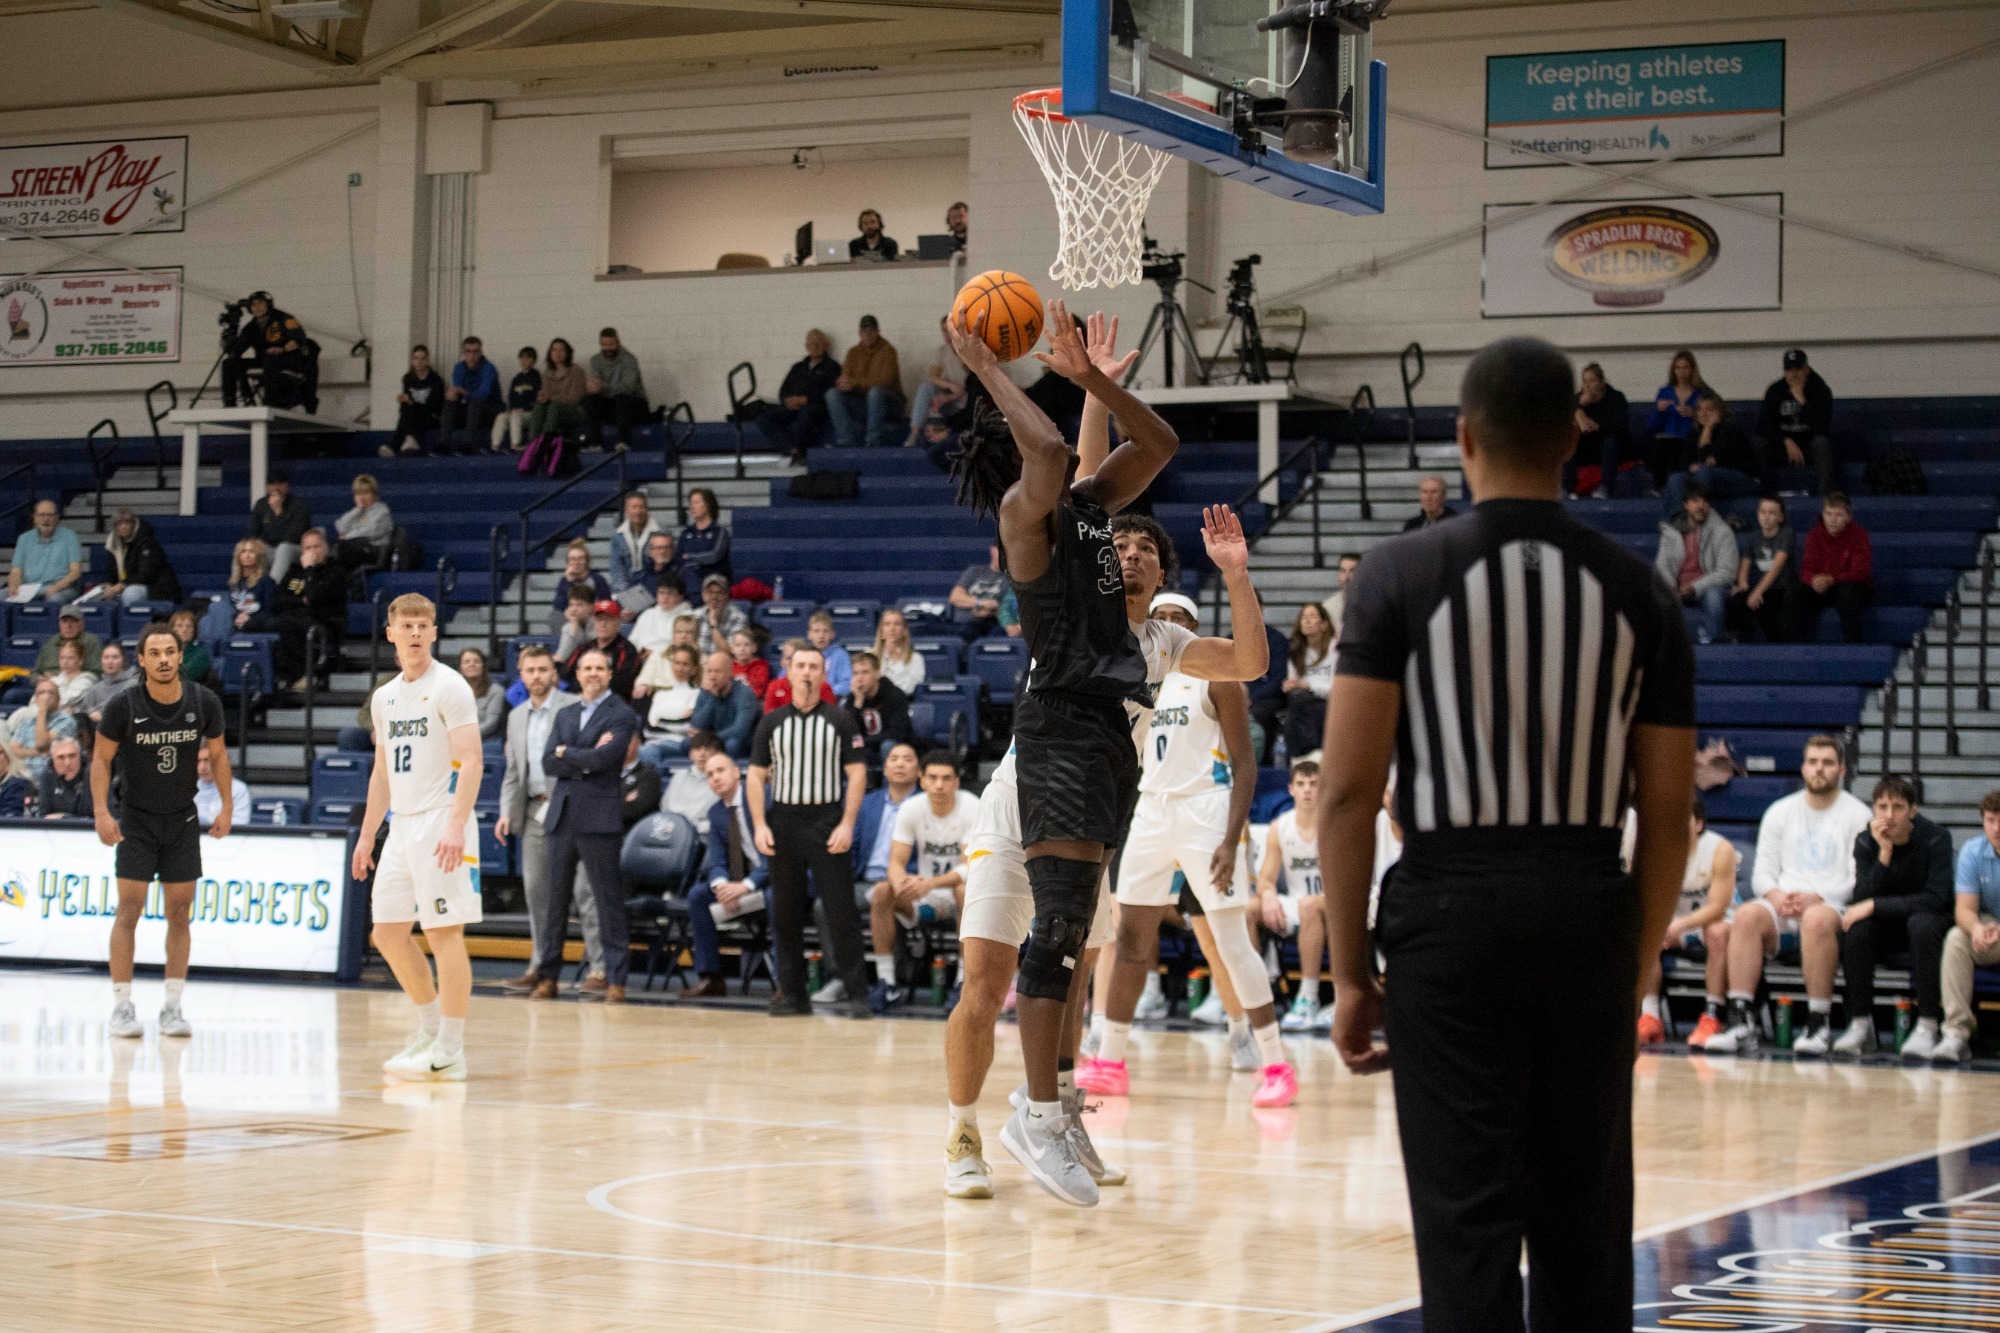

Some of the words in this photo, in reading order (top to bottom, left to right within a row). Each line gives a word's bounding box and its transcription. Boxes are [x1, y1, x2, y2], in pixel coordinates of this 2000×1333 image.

[1526, 59, 1631, 87] Keeping
[1638, 54, 1743, 80] athletes
[1552, 92, 1577, 112] at
[1585, 87, 1643, 110] their
[1651, 84, 1715, 107] best.
[19, 208, 100, 226] 374-2646
[1572, 223, 1642, 252] SPRADLIN
[1579, 248, 1681, 276] WELDING
[55, 341, 167, 357] 937-766-2046
[136, 729, 198, 745] PANTHERS
[1156, 733, 1168, 762] 0
[157, 745, 178, 774] 3
[394, 744, 412, 773] 12
[188, 879, 331, 931] ACKETS
